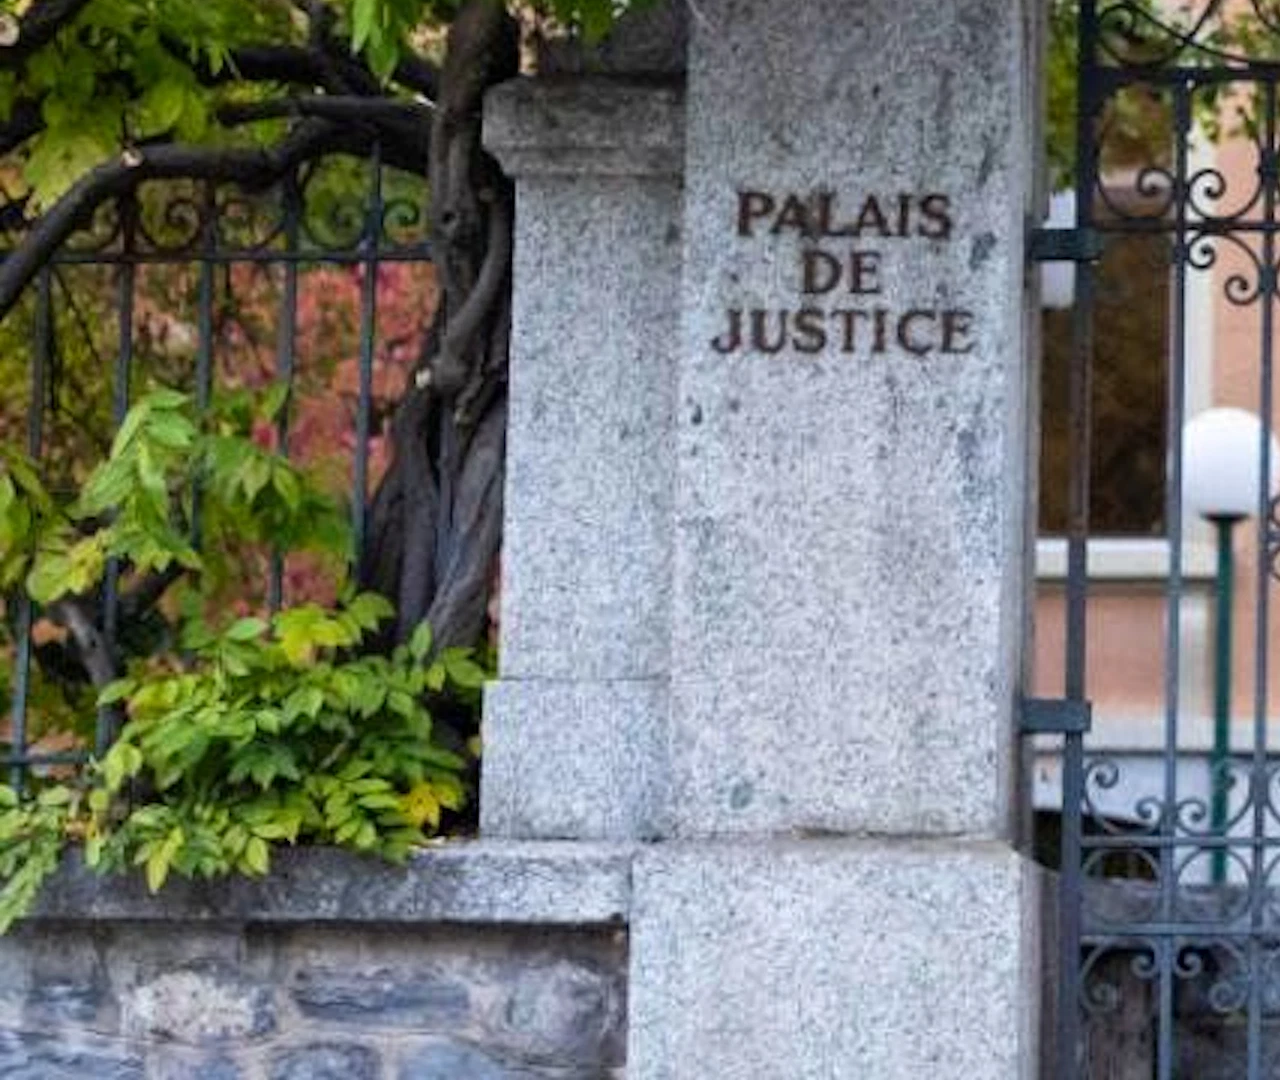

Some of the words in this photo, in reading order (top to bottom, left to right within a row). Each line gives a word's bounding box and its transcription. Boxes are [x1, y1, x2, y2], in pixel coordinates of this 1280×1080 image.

[736, 191, 953, 239] PALAIS
[802, 251, 883, 295] DE
[710, 308, 976, 356] JUSTICE
